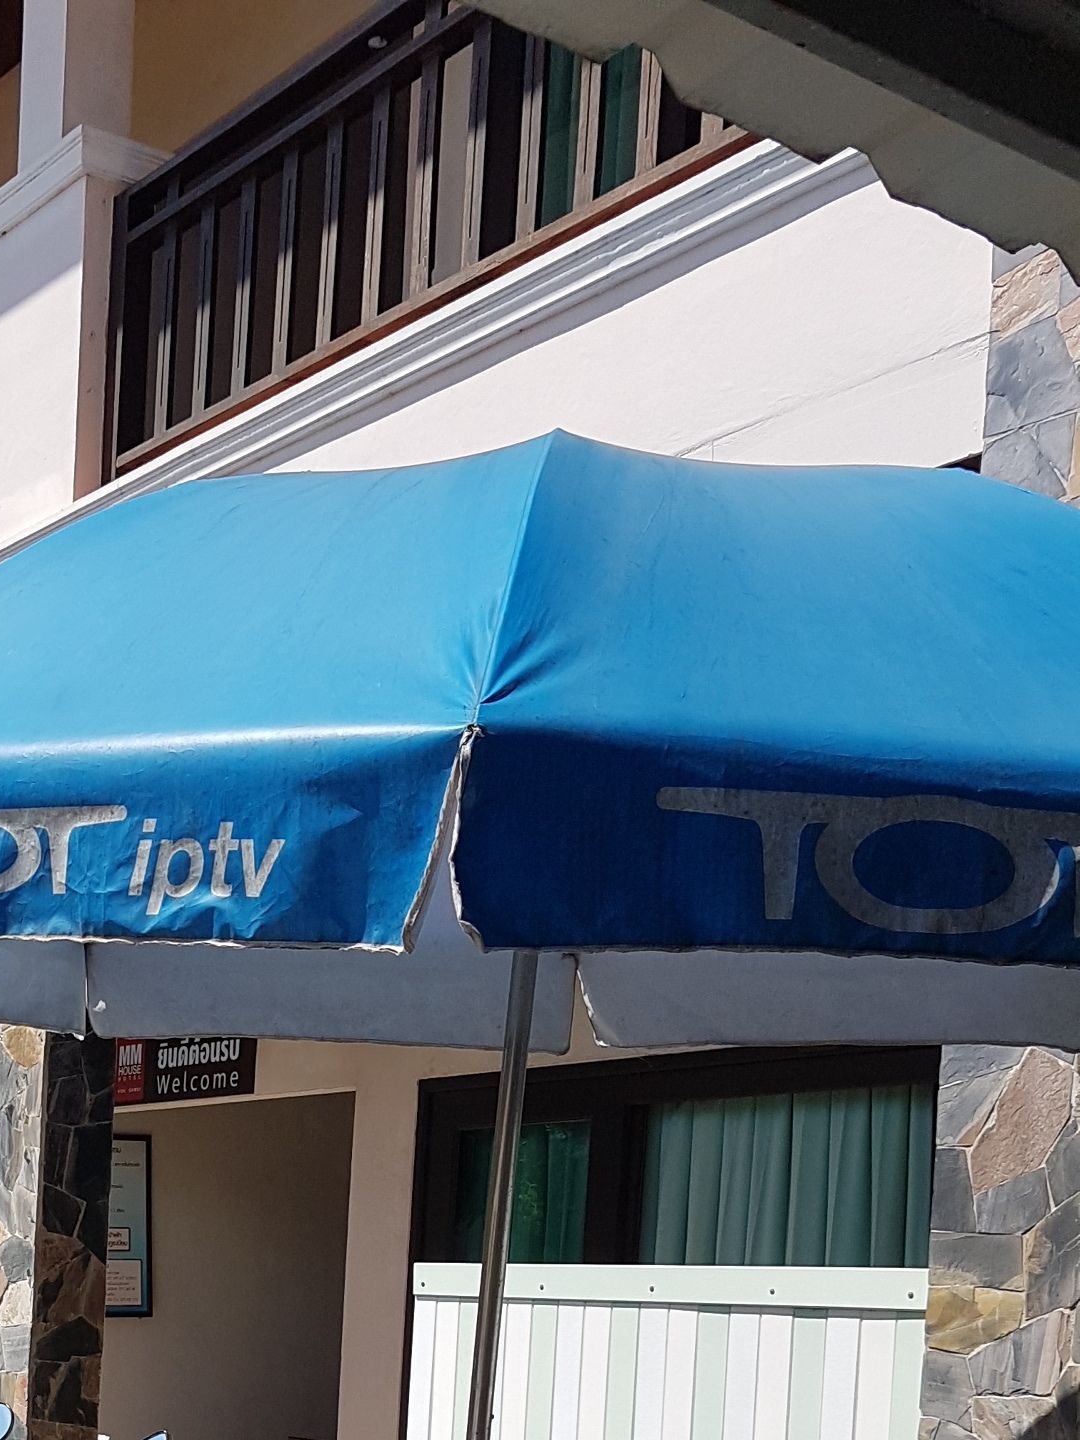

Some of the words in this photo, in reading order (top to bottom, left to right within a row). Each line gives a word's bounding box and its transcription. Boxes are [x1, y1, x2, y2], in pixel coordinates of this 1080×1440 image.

[127, 818, 286, 916] iptv
[656, 786, 1080, 938] TO
[119, 1043, 143, 1067] MM
[119, 1065, 141, 1076] HOUSE
[156, 1070, 239, 1095] Welcome
